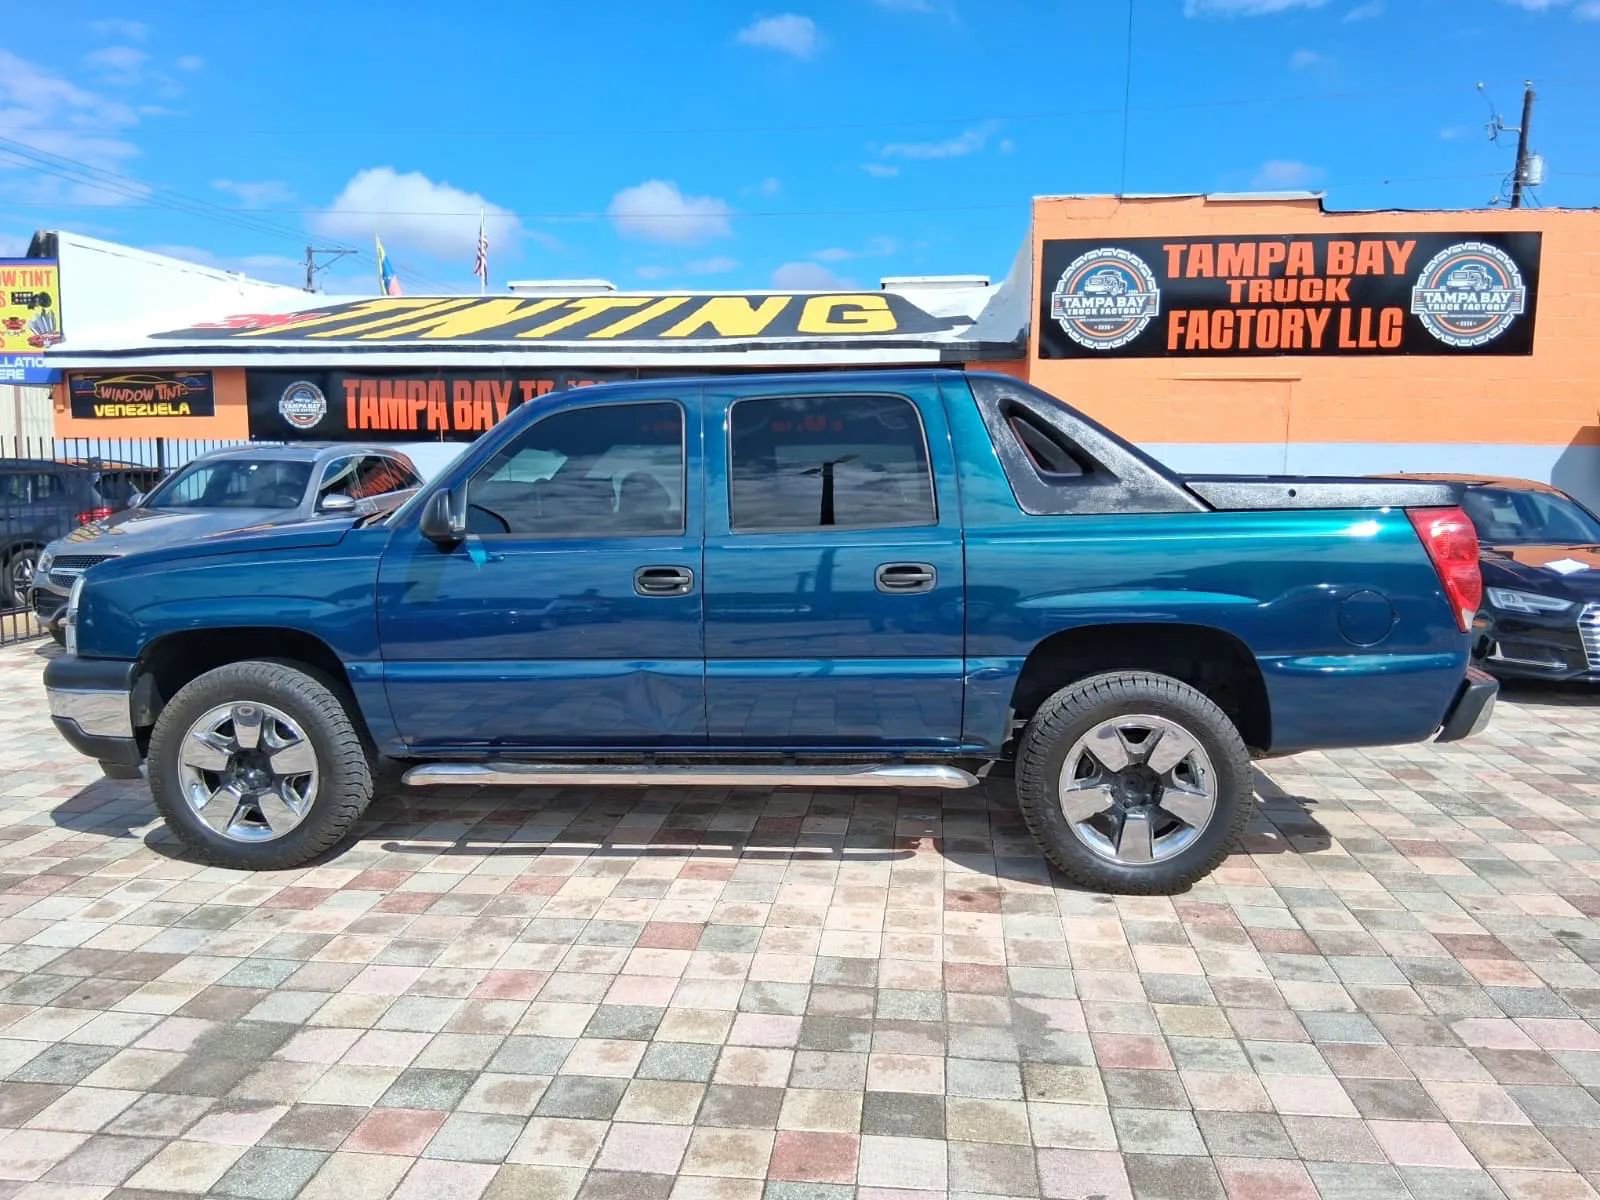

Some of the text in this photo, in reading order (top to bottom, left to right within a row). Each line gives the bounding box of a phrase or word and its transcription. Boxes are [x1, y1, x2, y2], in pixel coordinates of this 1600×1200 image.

[1163, 240, 1417, 278] TAMPA BAY
[0, 270, 52, 287] W TINT
[1226, 278, 1351, 304] TRUCK
[1424, 292, 1512, 304] TAMPA BAY
[1063, 296, 1147, 308] TAMPA BAY
[1428, 303, 1506, 311] TRUCK FACTORY
[1100, 307, 1142, 315] FACTORY
[1167, 306, 1404, 350] FACTORY LLC
[100, 383, 181, 402] WINDOW TINT
[94, 402, 191, 417] VENEZUELA
[342, 379, 449, 430] TAMPA
[452, 380, 513, 430] BAY
